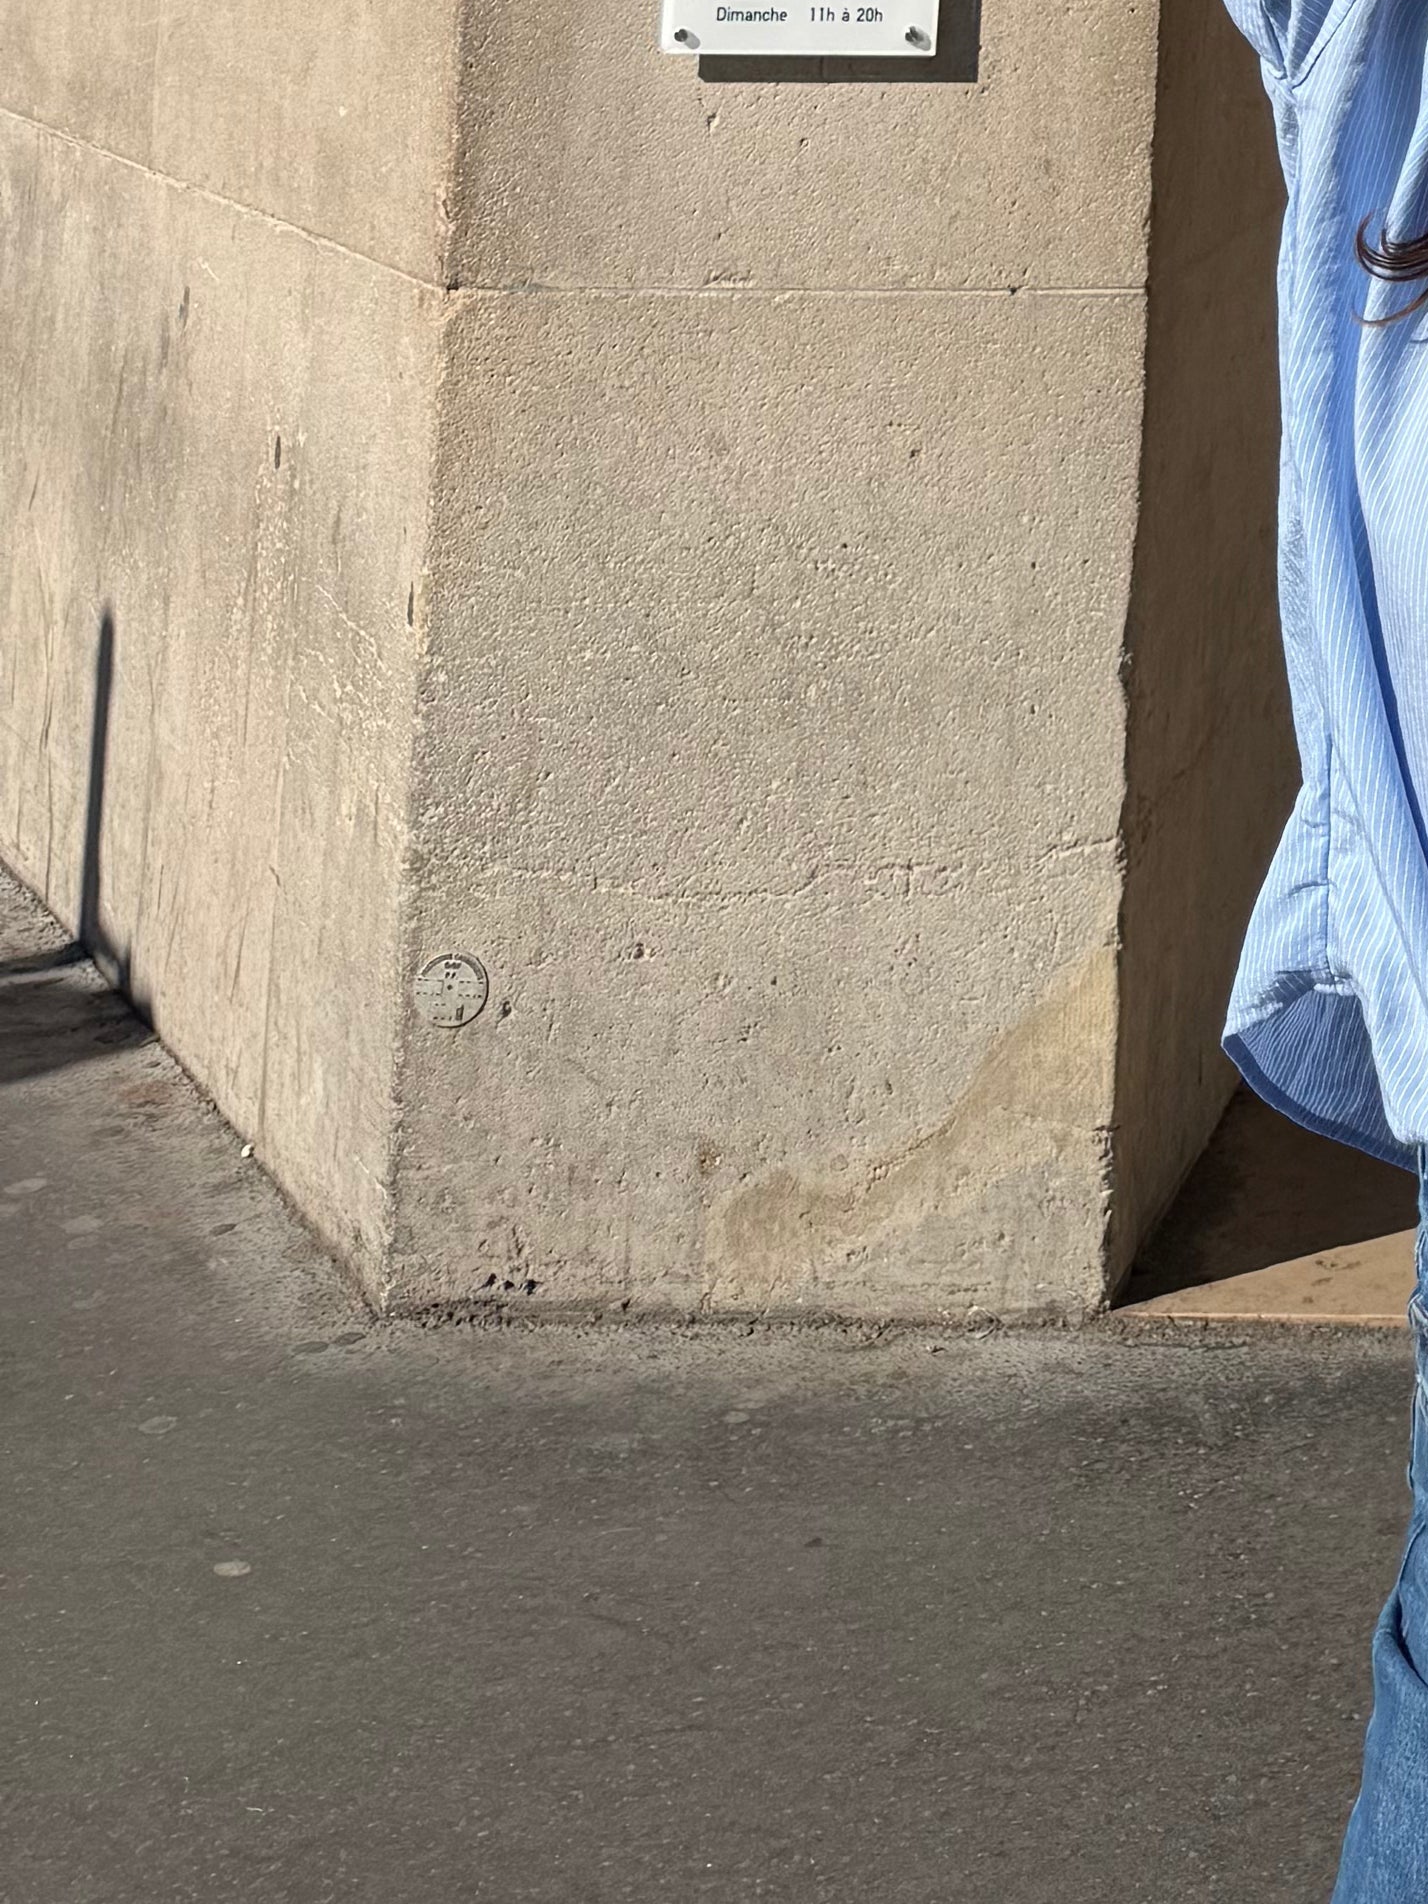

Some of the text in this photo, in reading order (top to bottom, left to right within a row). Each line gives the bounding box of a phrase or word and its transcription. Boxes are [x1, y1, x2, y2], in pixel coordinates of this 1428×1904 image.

[717, 7, 882, 22] Dimanche 11h à 20h
